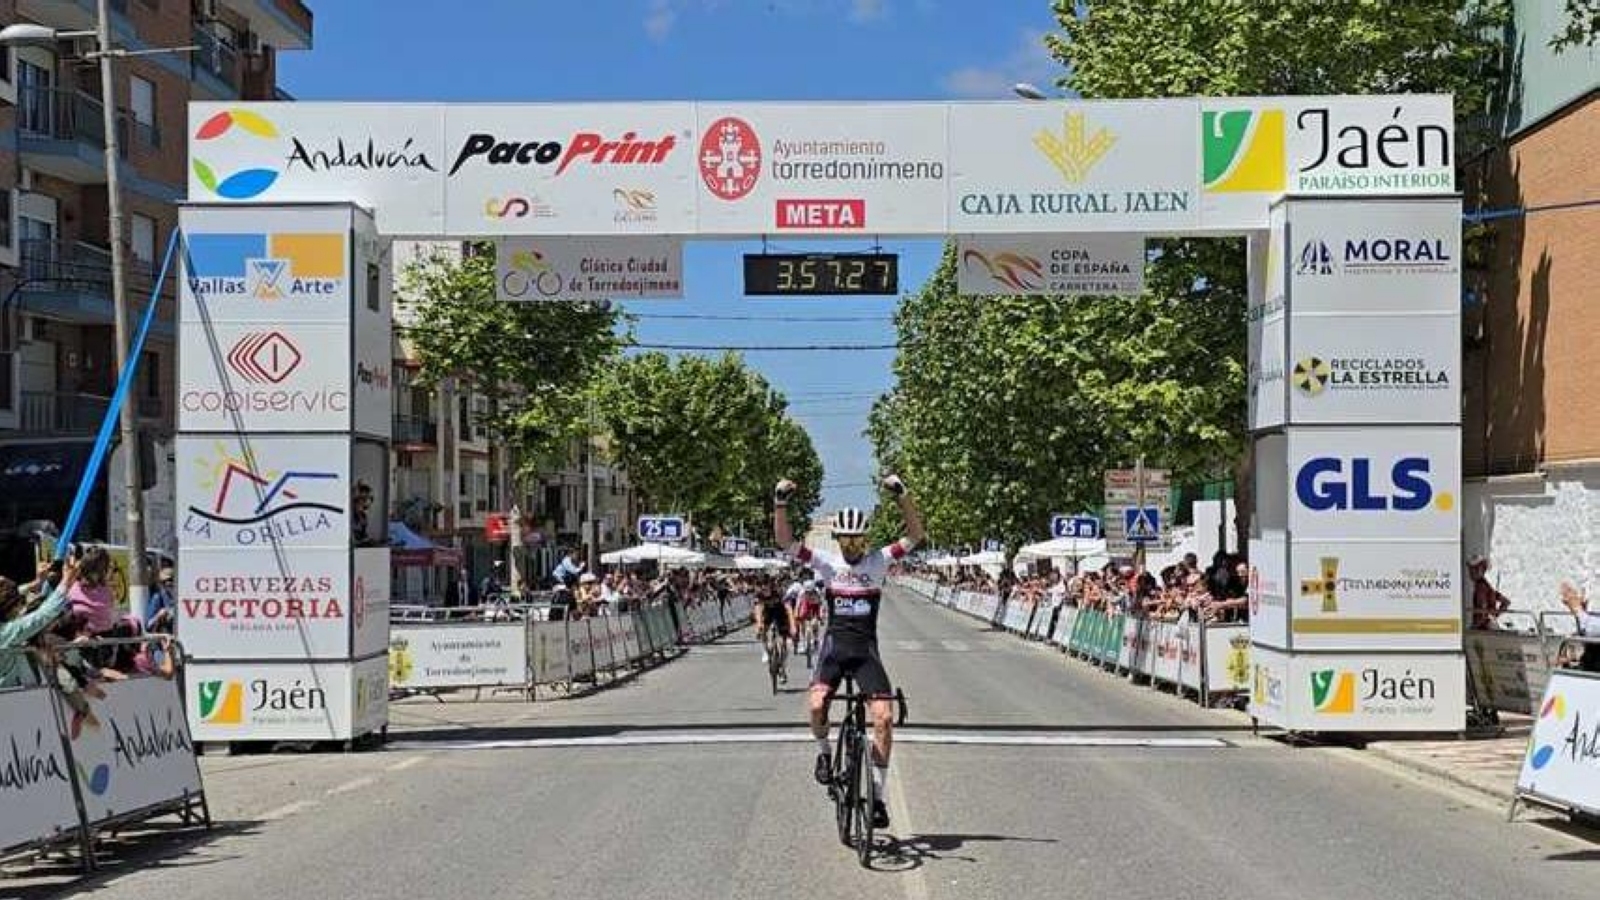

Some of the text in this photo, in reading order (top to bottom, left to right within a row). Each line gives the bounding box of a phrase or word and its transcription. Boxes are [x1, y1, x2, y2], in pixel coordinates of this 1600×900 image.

[772, 139, 885, 158] Ayuntamiento
[1297, 107, 1450, 172] Jaén
[1373, 172, 1451, 188] INTERIOR
[961, 193, 1022, 216] CAJA
[1030, 192, 1117, 214] RURAL
[785, 203, 856, 226] META
[1051, 249, 1090, 261] COPA
[1344, 239, 1451, 261] MORAL
[1051, 261, 1131, 274] DE ESPAÑA
[290, 279, 334, 294] Arte
[1330, 358, 1426, 370] RECICLADOS
[1330, 371, 1450, 384] LA ESTRELLA
[183, 512, 332, 545] LA ORILLA
[645, 520, 661, 536] 25
[1060, 519, 1092, 536] 25 m
[195, 577, 332, 594] CERVEZAS
[182, 598, 344, 620] VICTORIA
[1362, 668, 1435, 700] Jaén
[250, 680, 326, 711] Jaén
